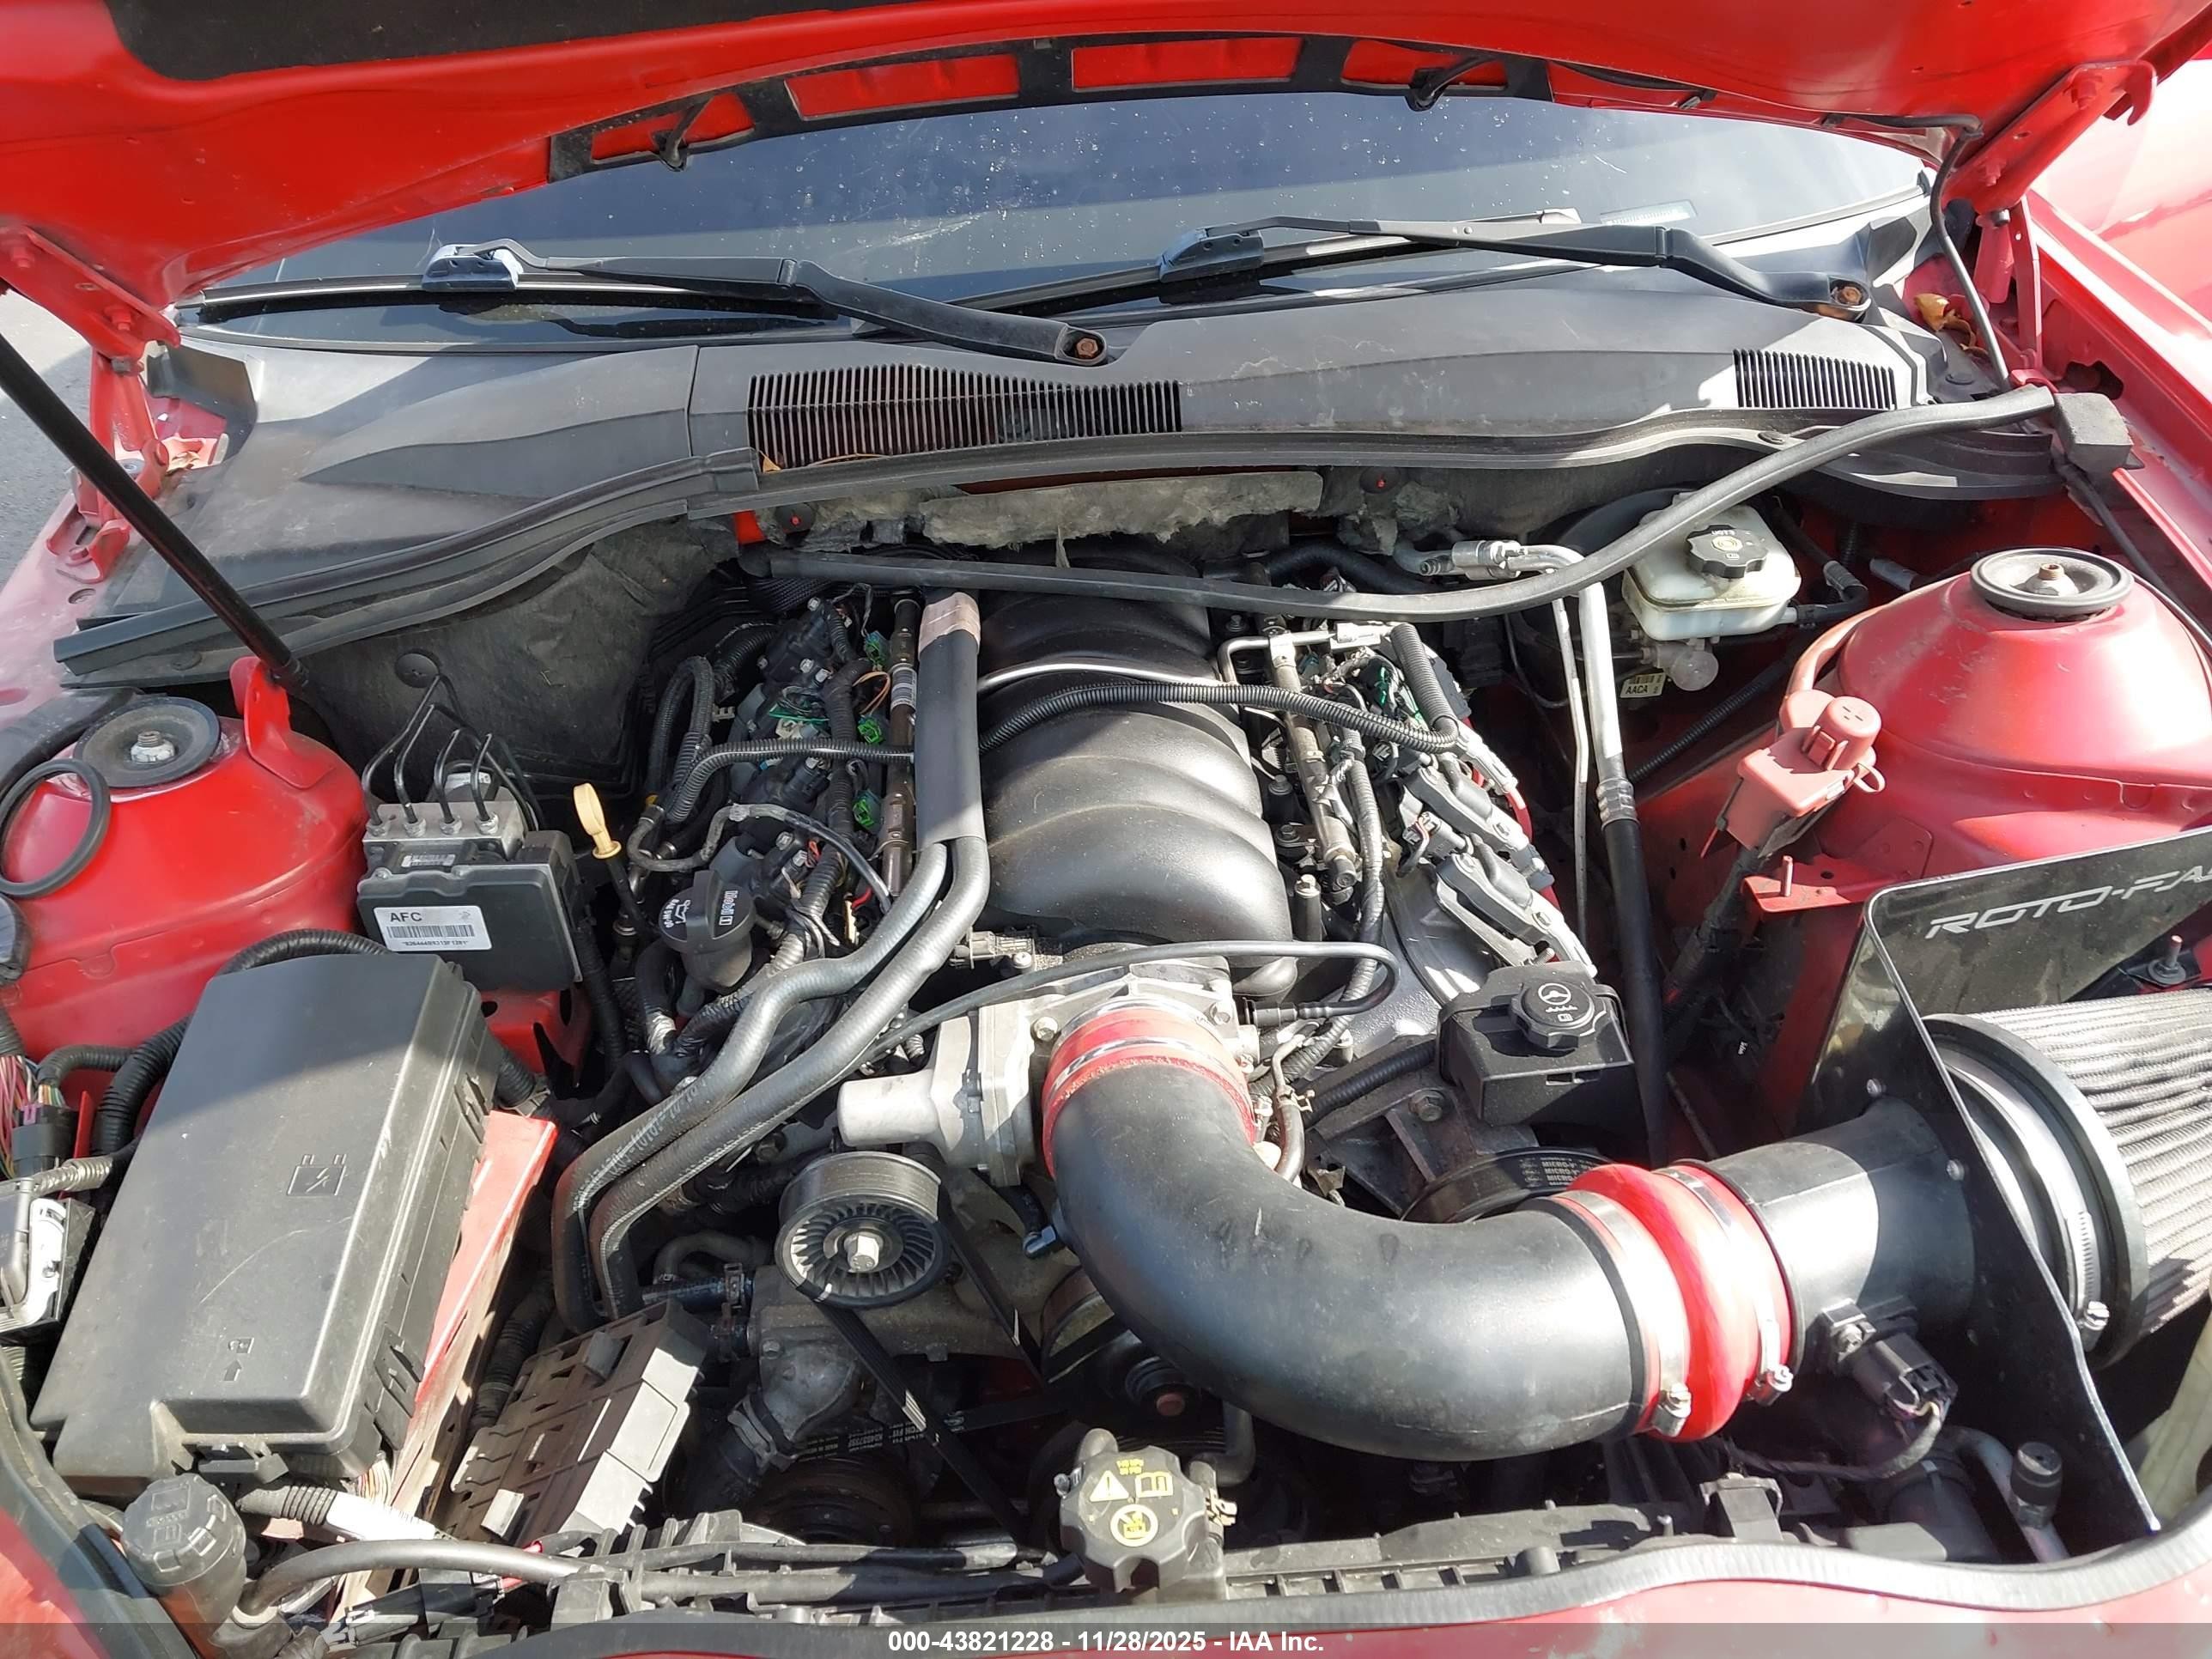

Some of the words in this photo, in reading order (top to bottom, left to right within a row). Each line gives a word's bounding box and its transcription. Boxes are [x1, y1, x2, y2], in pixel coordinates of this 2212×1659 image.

[1625, 684, 1649, 694] AACA
[720, 890, 738, 915] Mobil
[390, 912, 422, 922] AFC
